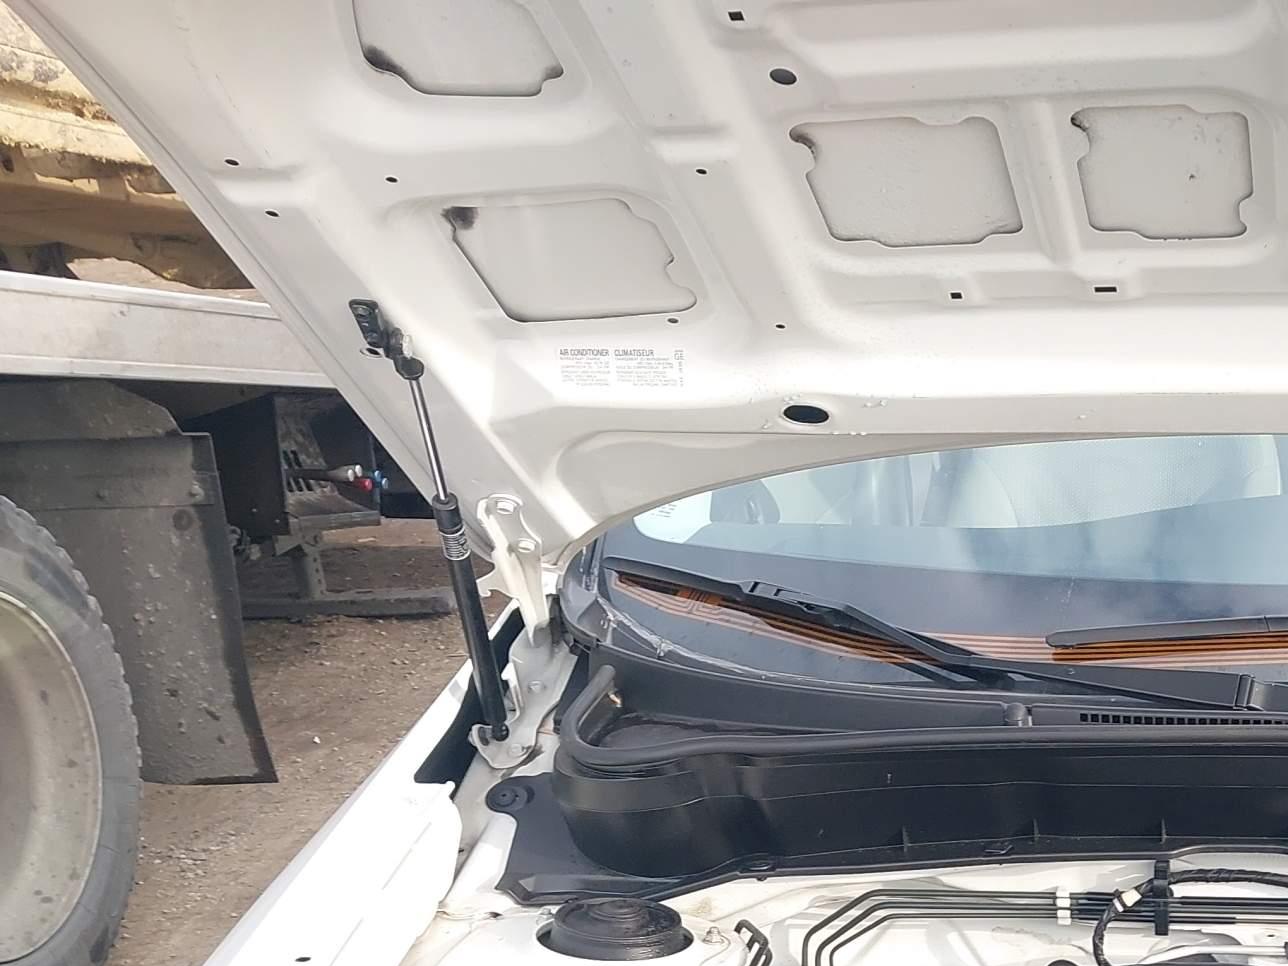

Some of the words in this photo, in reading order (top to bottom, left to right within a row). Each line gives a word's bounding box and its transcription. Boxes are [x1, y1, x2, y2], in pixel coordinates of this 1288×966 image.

[560, 349, 569, 357] AIR
[570, 349, 609, 357] CONDITIONER
[614, 349, 655, 357] CLIMATISEUR
